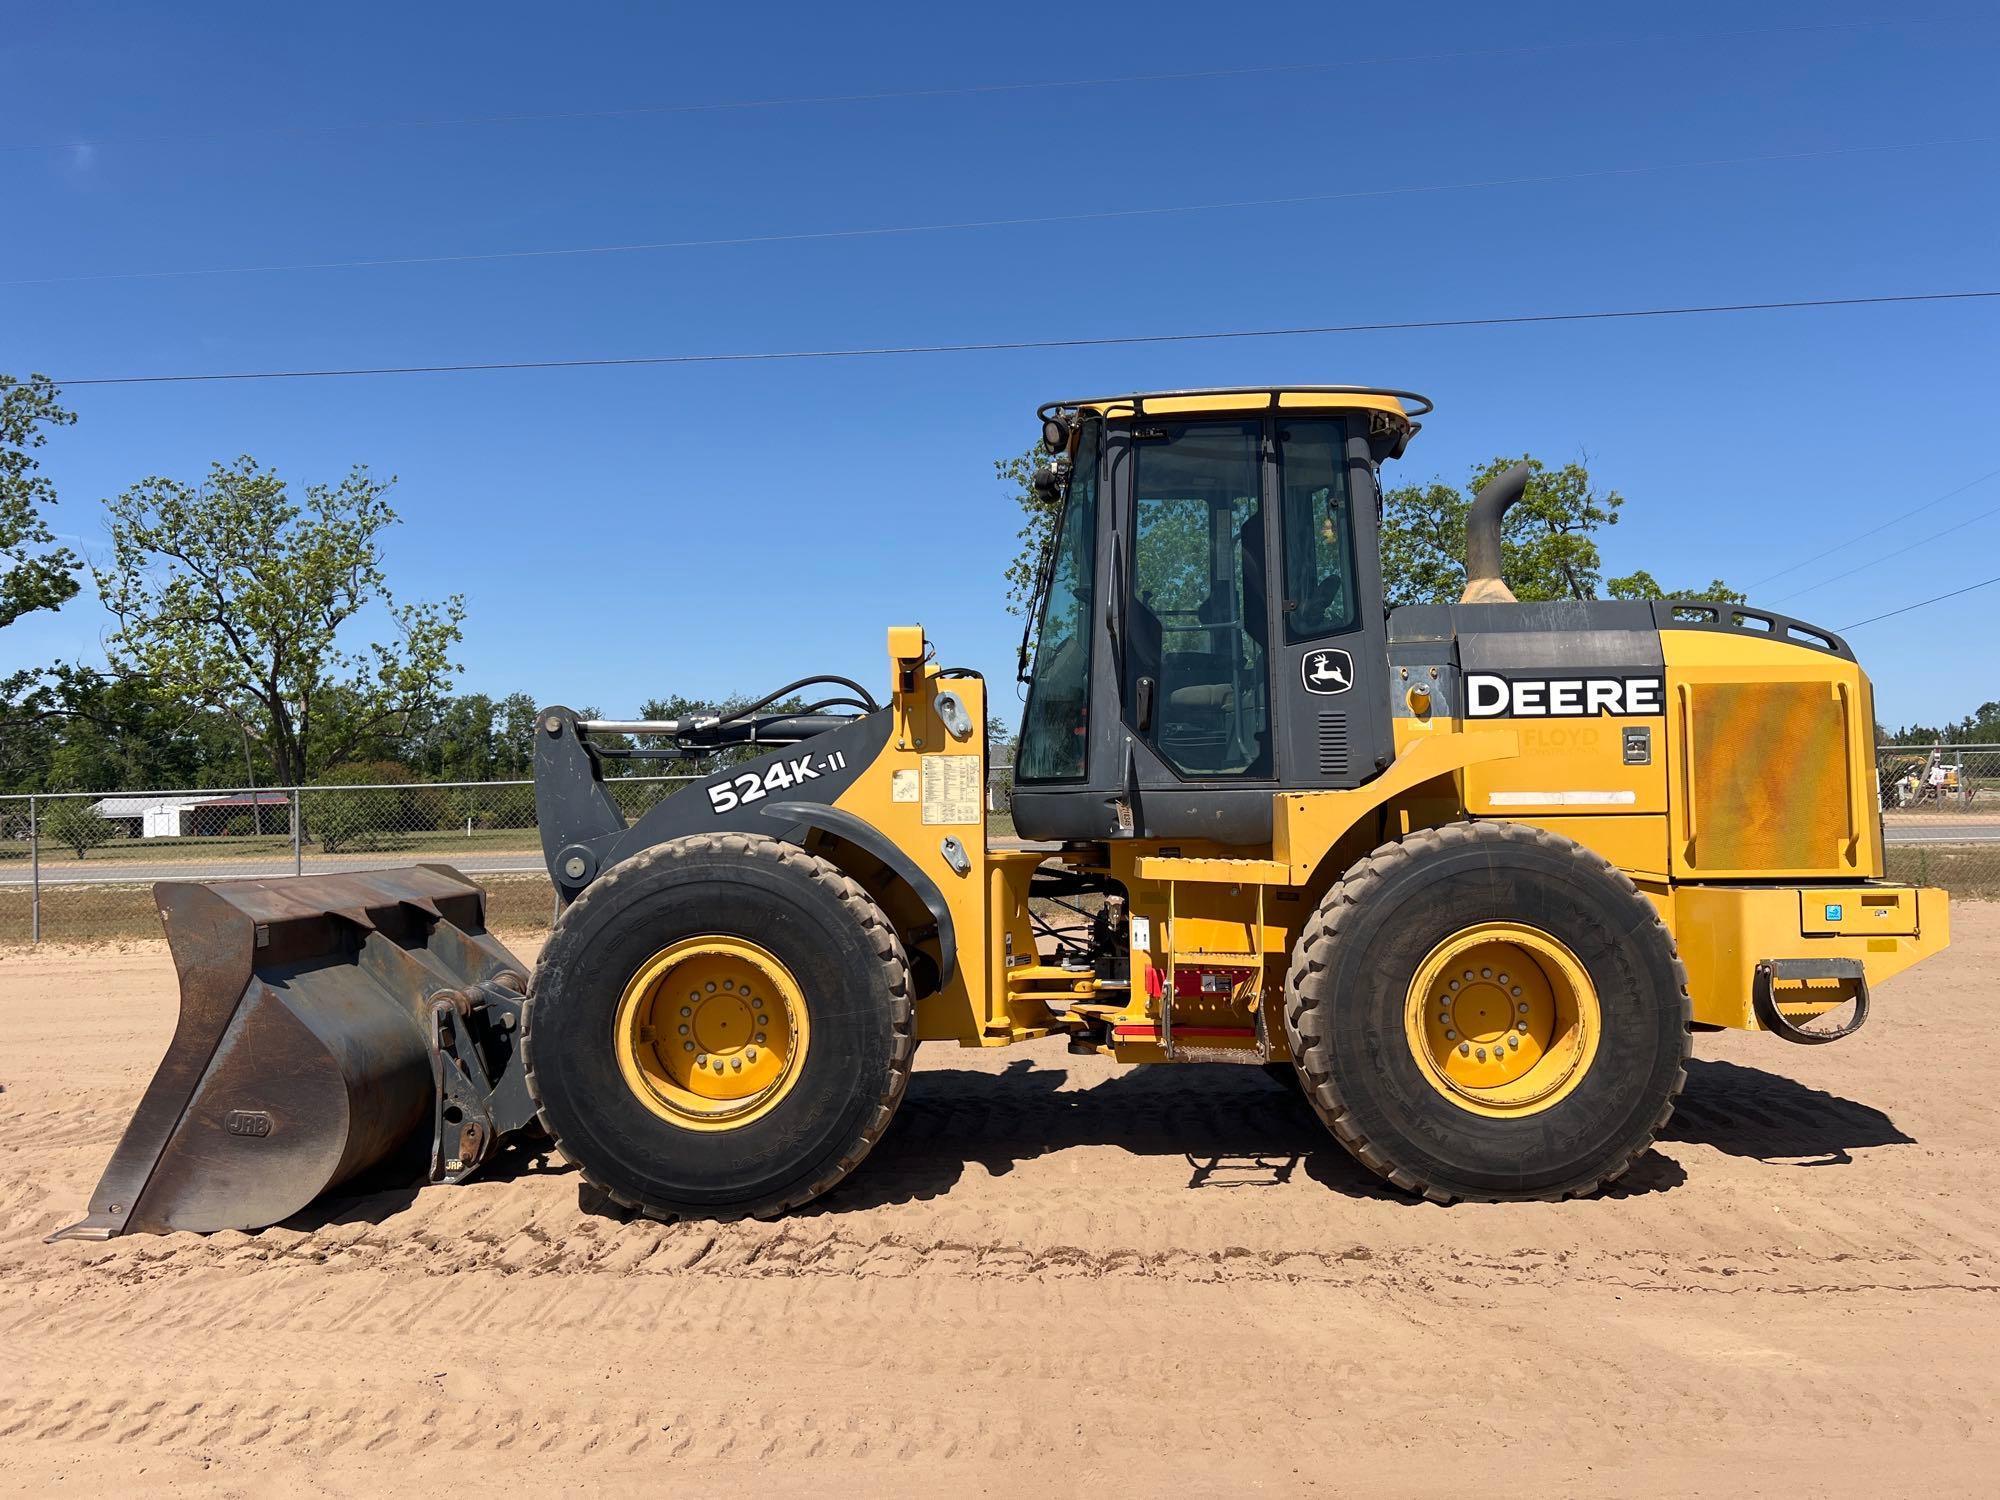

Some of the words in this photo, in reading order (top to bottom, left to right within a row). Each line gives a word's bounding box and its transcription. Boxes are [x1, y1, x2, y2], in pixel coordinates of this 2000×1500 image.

[1467, 675, 1661, 716] DEERE
[1523, 728, 1599, 747] FLOYD
[229, 1113, 269, 1134] JRB
